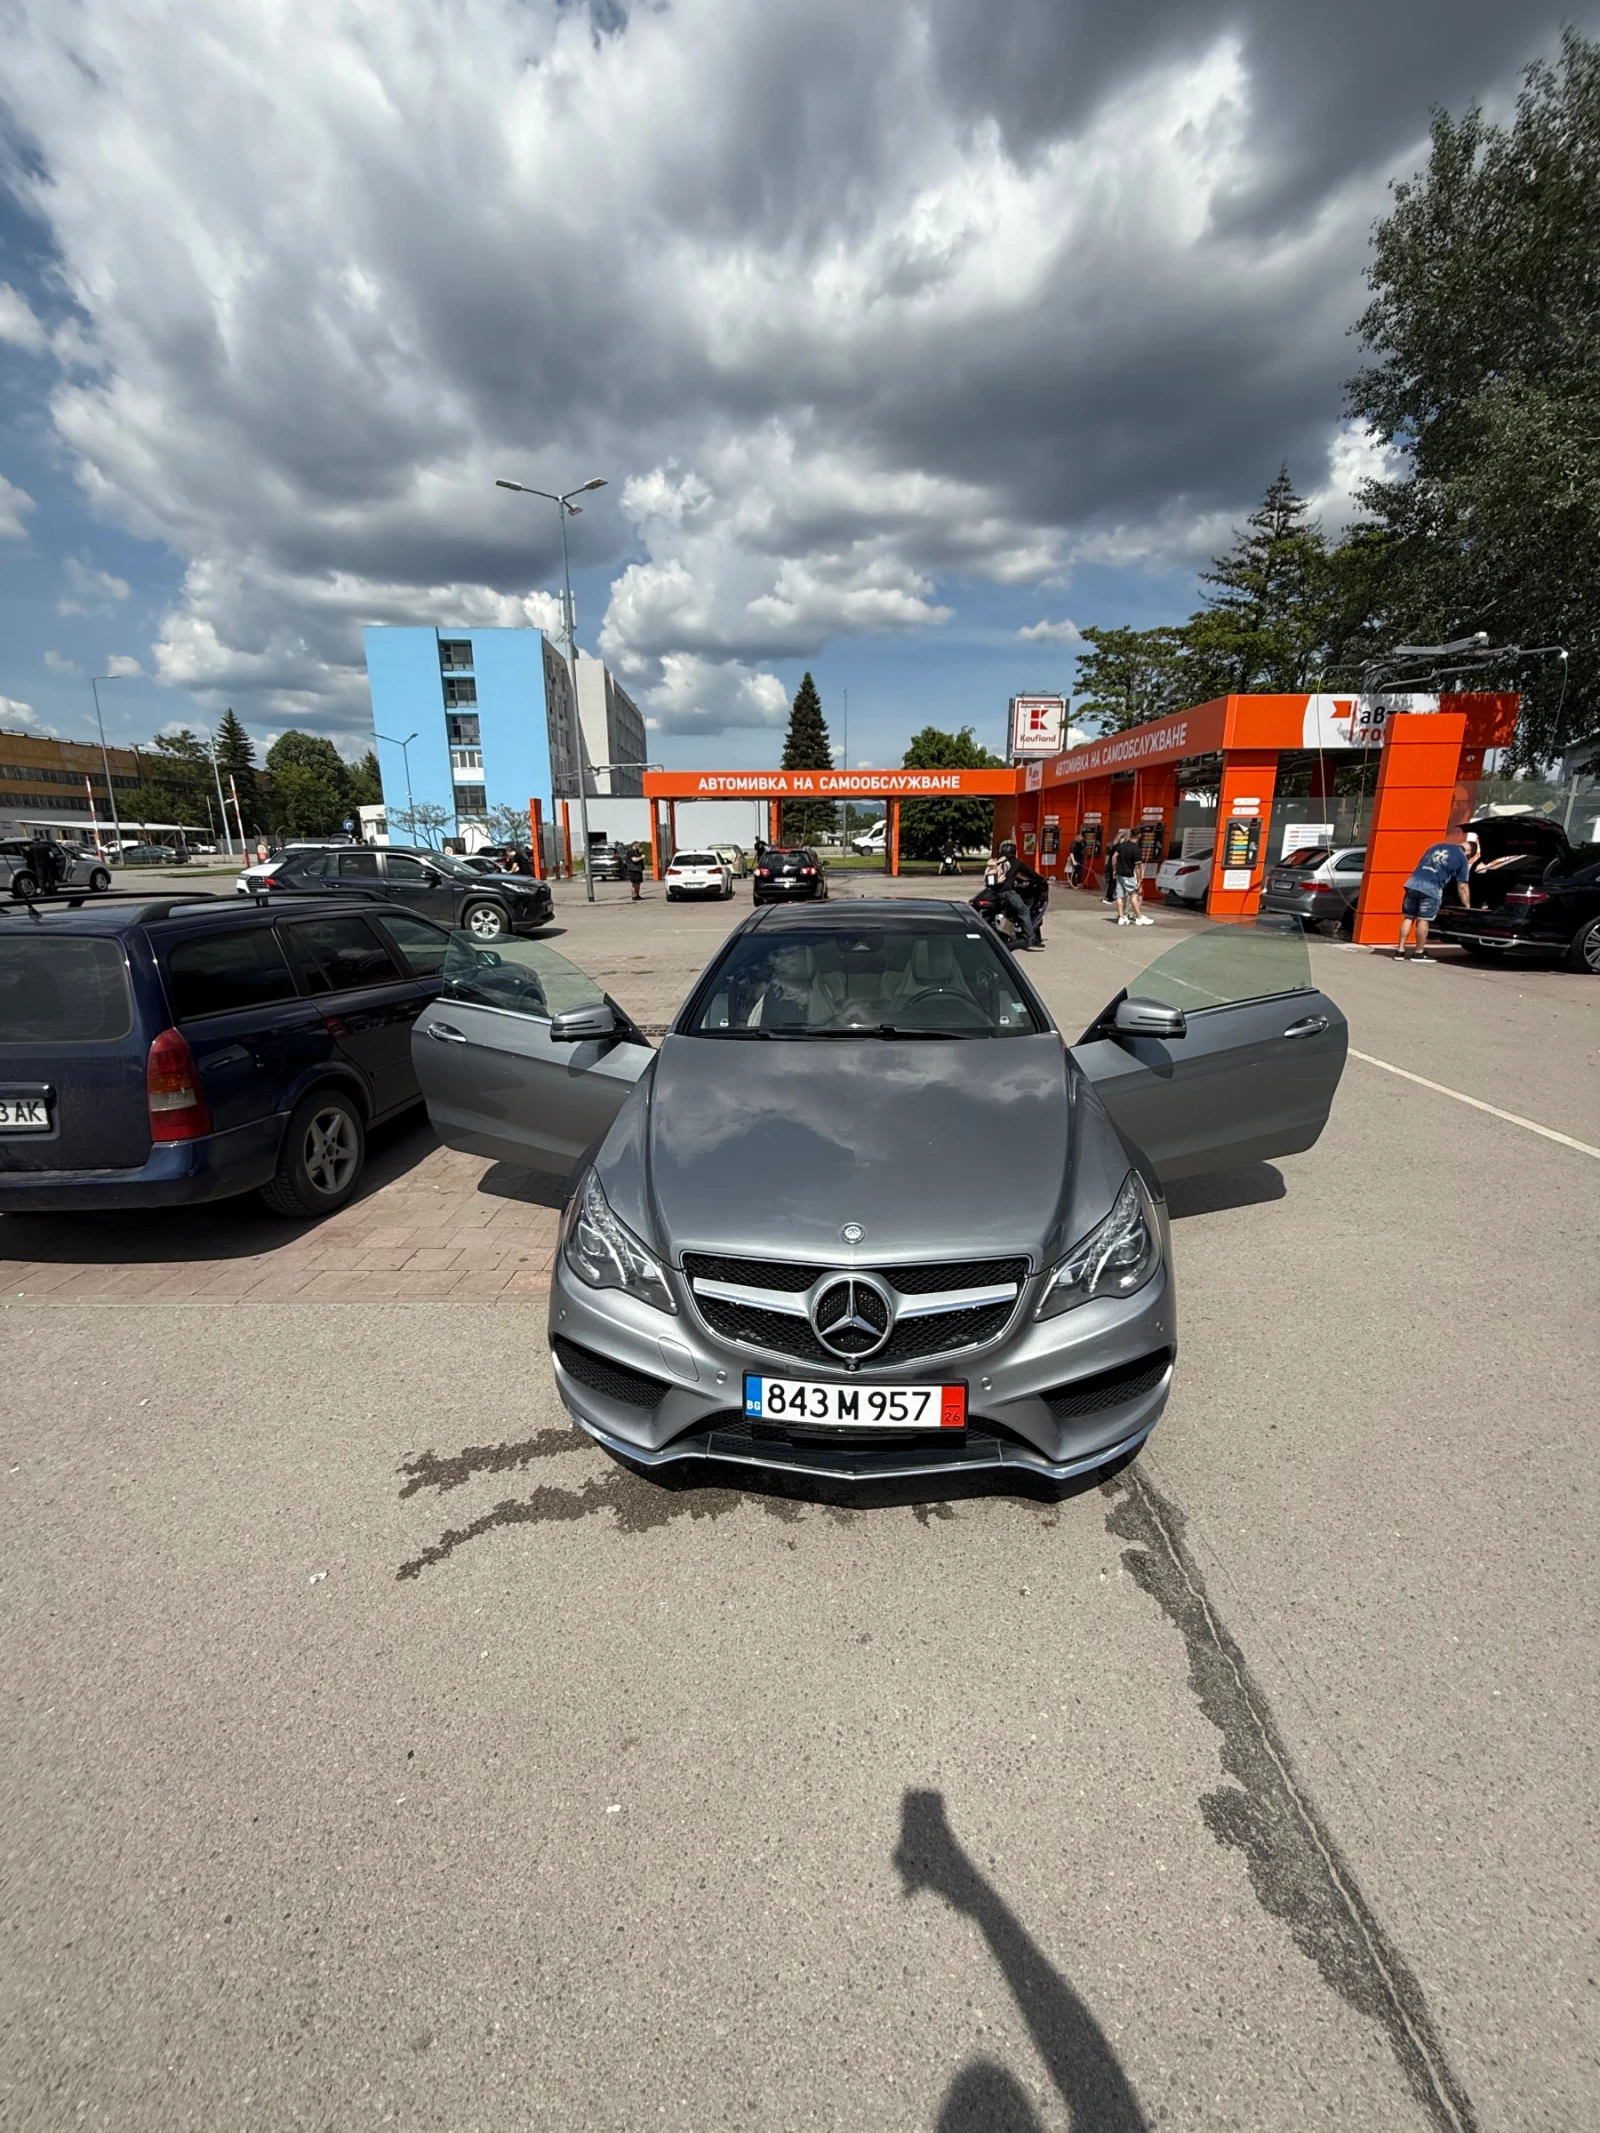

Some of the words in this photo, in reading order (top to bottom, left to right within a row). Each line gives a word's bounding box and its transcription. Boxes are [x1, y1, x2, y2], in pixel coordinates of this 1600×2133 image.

[1019, 734, 1056, 743] Kaufland
[1055, 753, 1090, 778] АВТОМИВКА
[1090, 752, 1101, 766] НА
[1102, 722, 1188, 765] САМООБСЛУЖВАНЕ
[698, 777, 788, 791] АВТОМИВКА
[793, 777, 814, 790] НА
[819, 775, 961, 790] САМООБСЛУЖВАНЕ
[15, 1101, 44, 1123] AK
[746, 1400, 761, 1411] BG
[767, 1383, 829, 1418] 843
[837, 1389, 860, 1421] M
[867, 1391, 932, 1422] 957
[944, 1411, 961, 1423] 26
